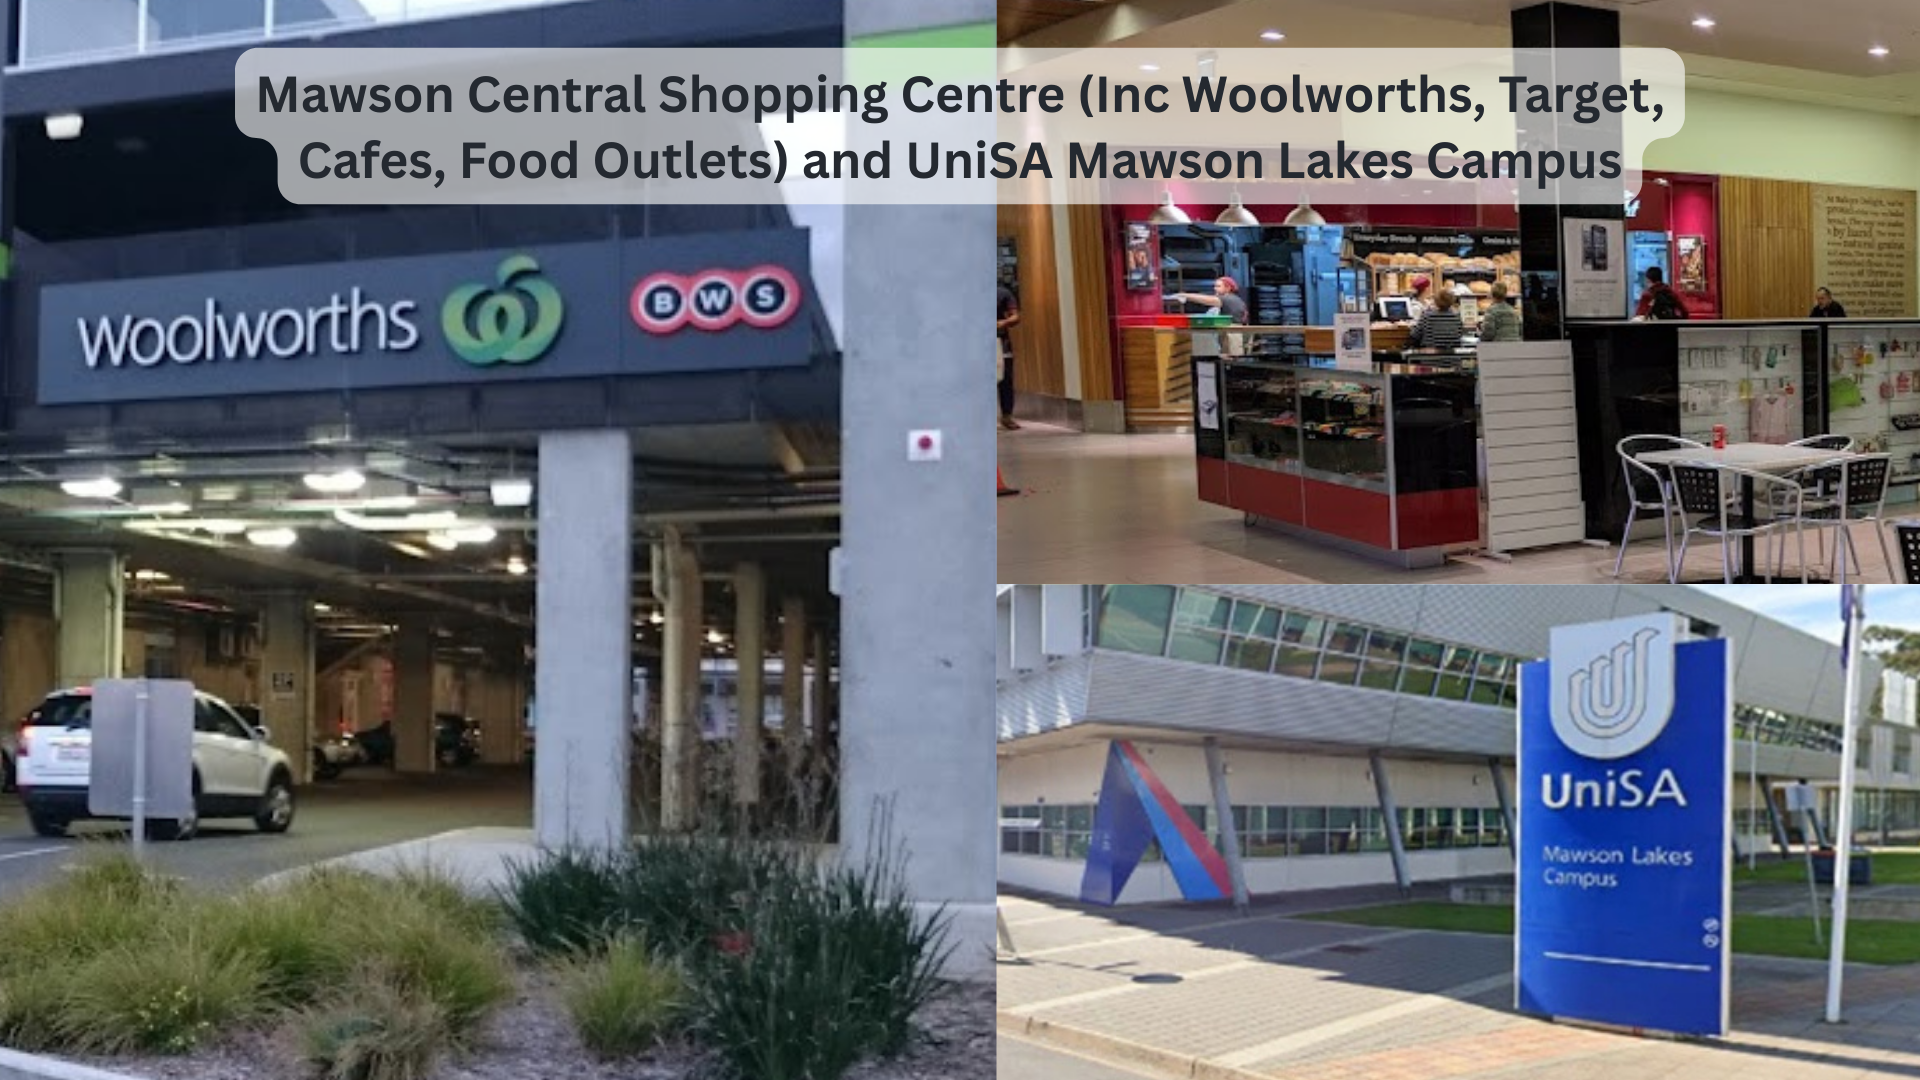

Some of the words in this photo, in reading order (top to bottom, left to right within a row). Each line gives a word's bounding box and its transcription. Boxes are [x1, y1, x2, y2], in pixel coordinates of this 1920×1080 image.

[1833, 226, 1846, 239] by
[654, 284, 776, 313] BWS
[1541, 768, 1688, 809] UniSA
[1543, 845, 1624, 864] Mawson
[1632, 846, 1693, 866] Lakes
[1543, 868, 1618, 889] Campus
